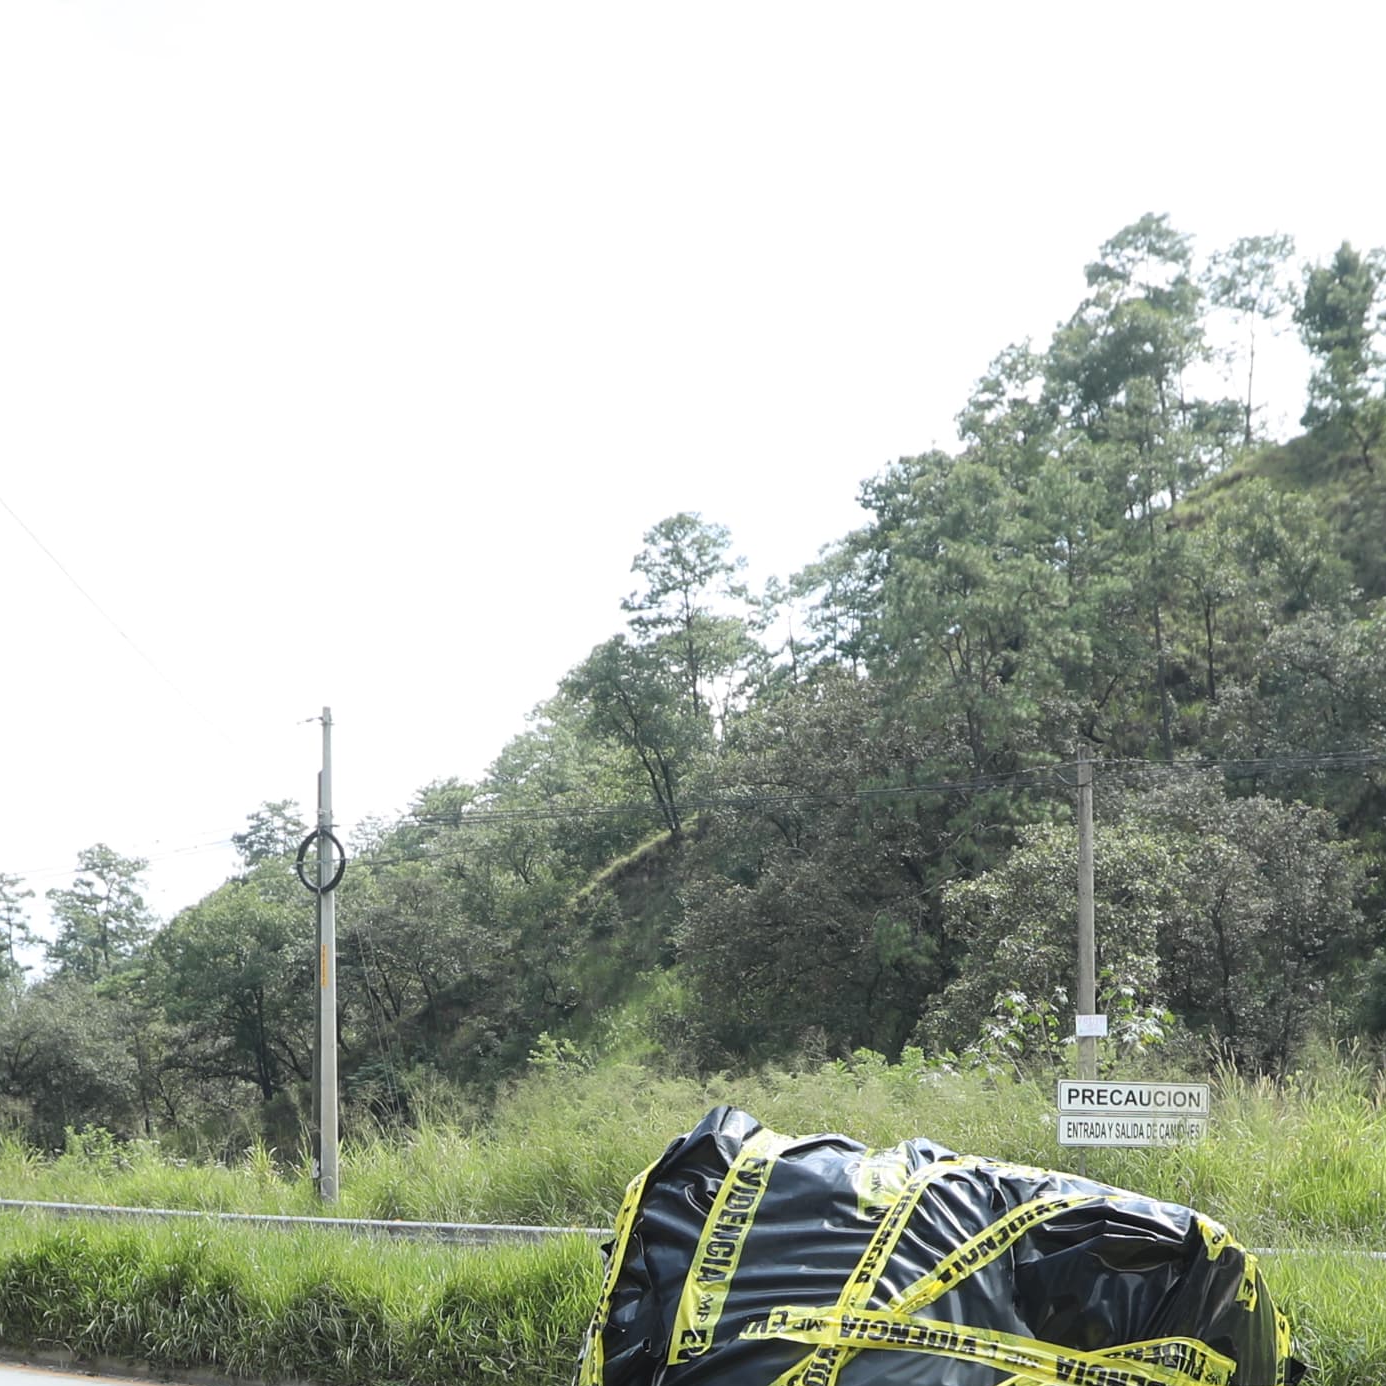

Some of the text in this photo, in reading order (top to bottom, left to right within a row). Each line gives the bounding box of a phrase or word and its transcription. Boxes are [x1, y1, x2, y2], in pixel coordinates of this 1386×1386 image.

[1067, 1088, 1201, 1108] PRECAUCION
[1066, 1121, 1105, 1139] ENTRADA
[1107, 1122, 1114, 1138] Y
[1115, 1122, 1145, 1139] SALIDA
[1146, 1123, 1158, 1139] DE
[696, 1156, 770, 1283] EVIDENCIA
[837, 1313, 999, 1360] EVIDENCIA
